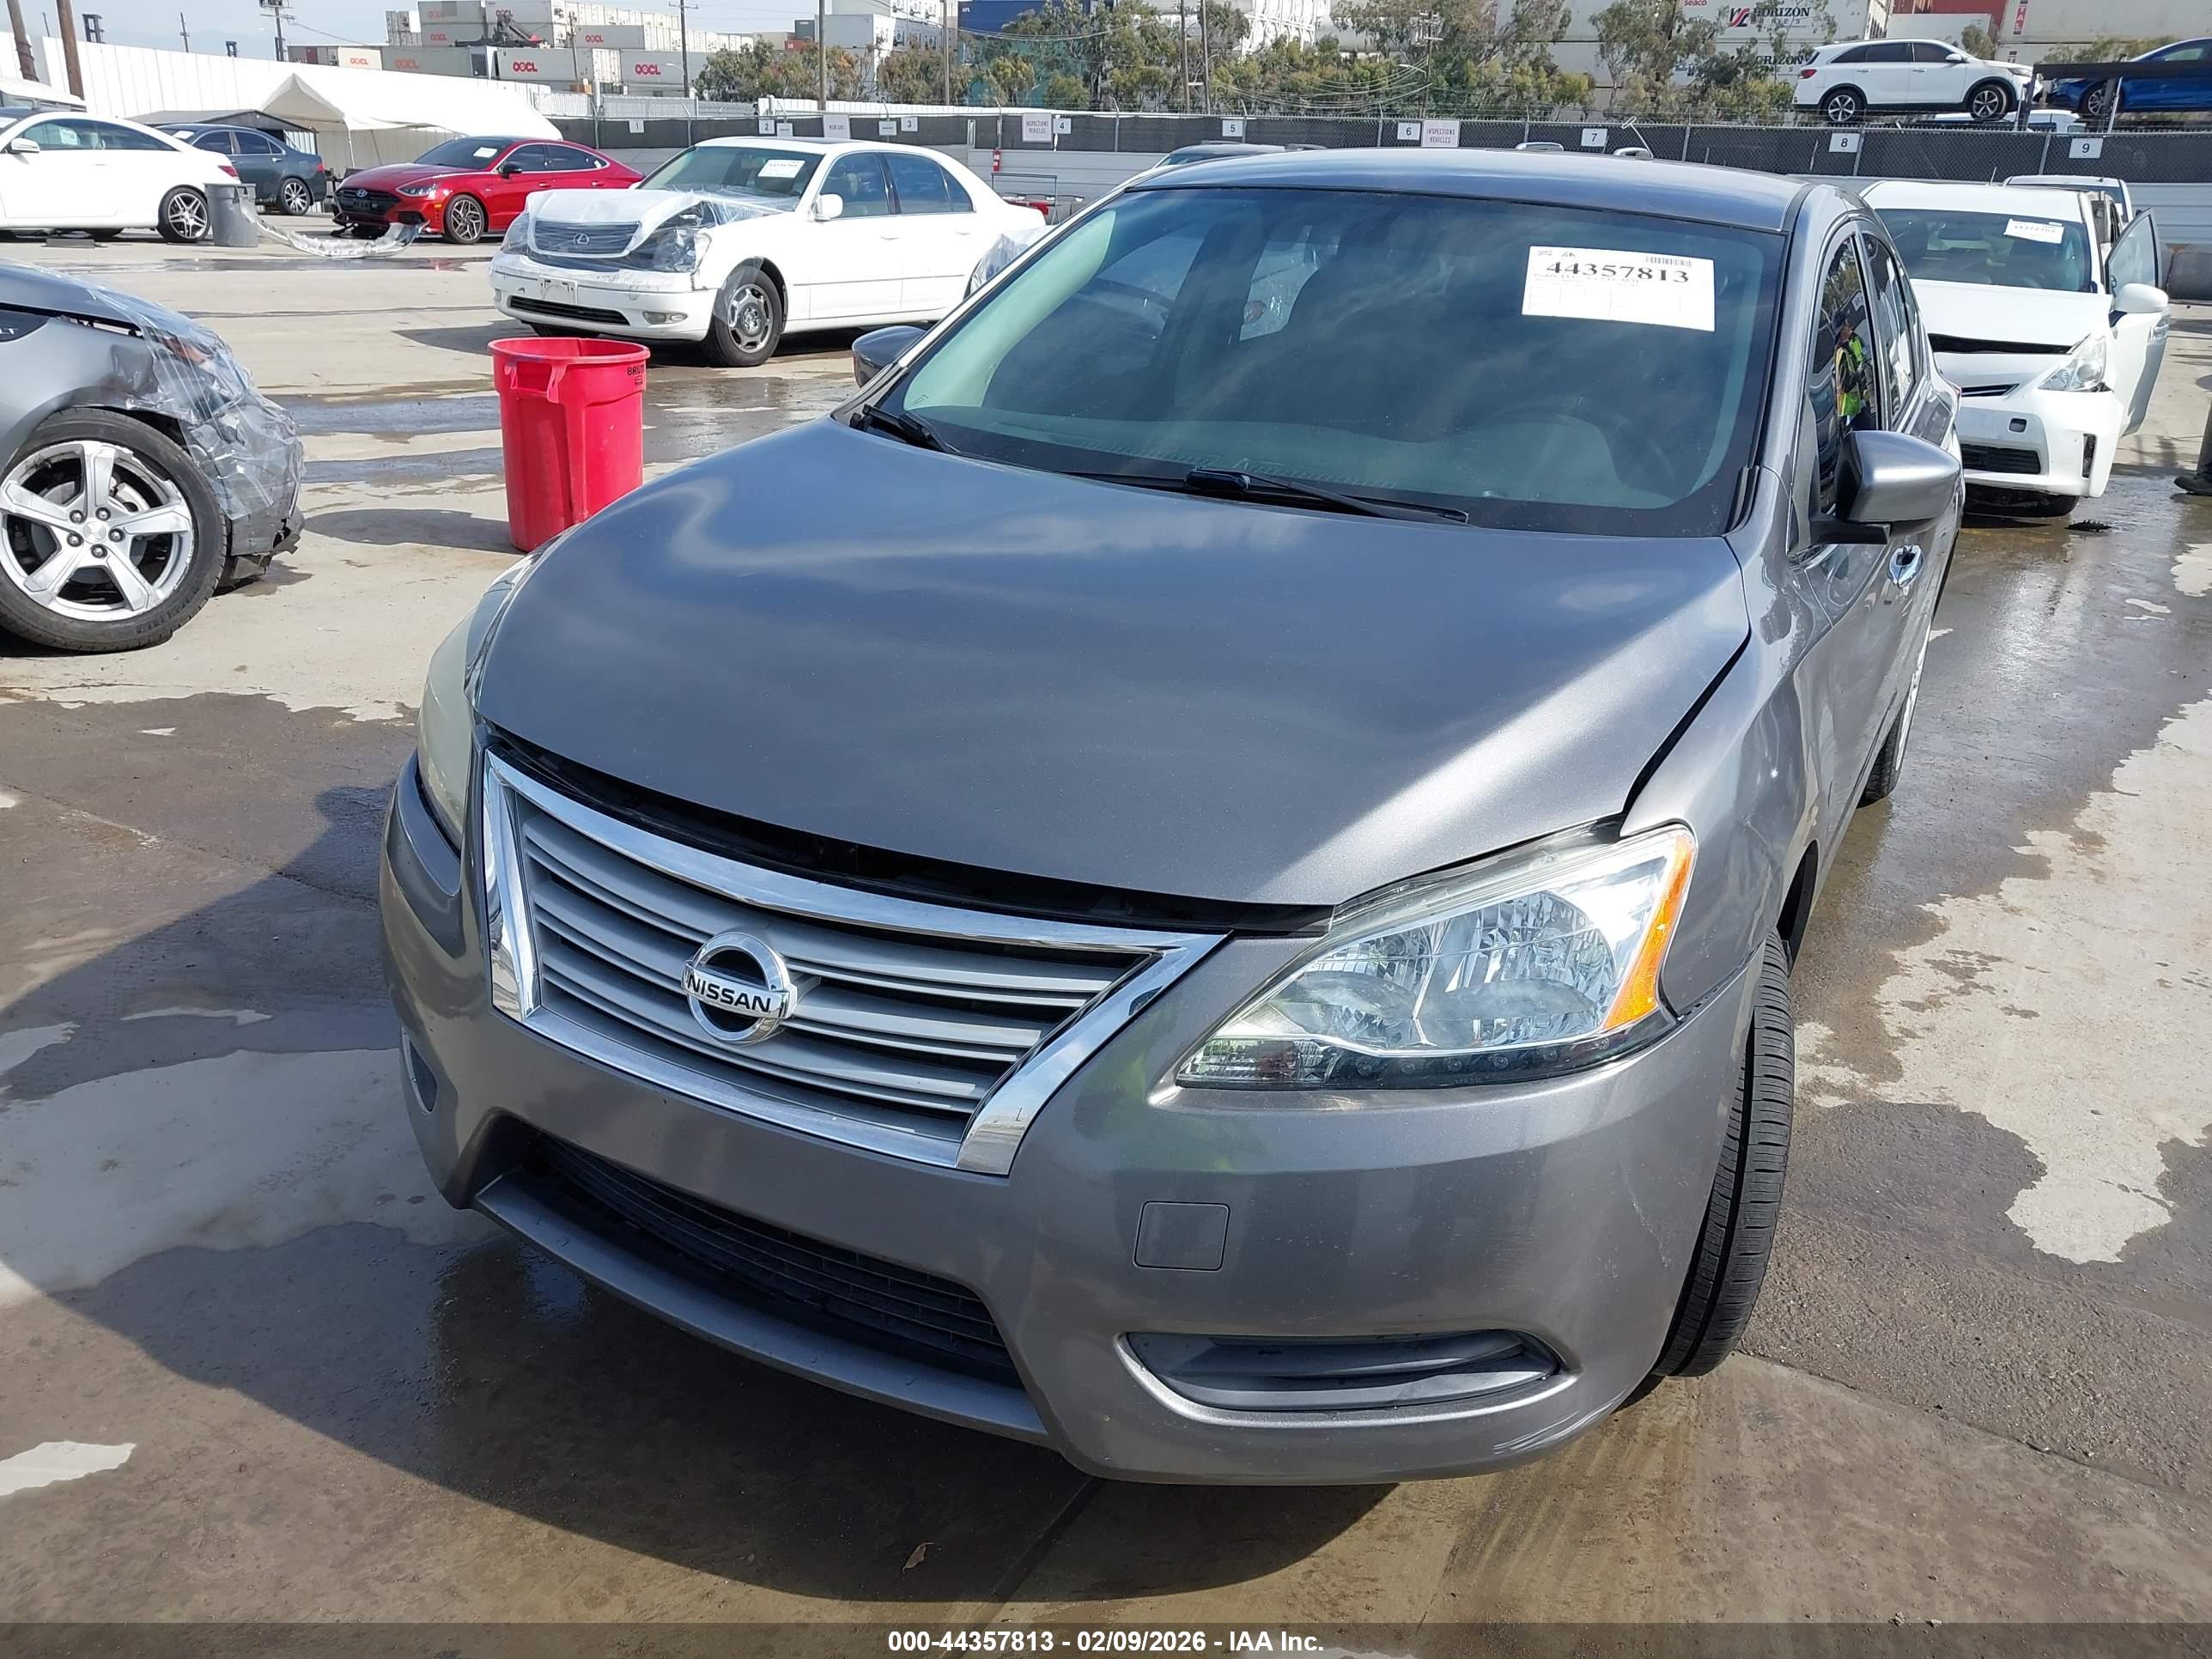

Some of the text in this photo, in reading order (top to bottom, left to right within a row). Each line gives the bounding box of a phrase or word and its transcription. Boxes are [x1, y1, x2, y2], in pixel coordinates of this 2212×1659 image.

[586, 34, 604, 43] OOCL
[513, 62, 538, 72] OOCL
[635, 64, 660, 76] OOCL
[1230, 124, 1236, 133] 5
[1406, 127, 1413, 136] 6
[1591, 132, 1598, 142] 7
[1840, 137, 1848, 147] 8
[2081, 143, 2090, 154] 9
[1546, 261, 1689, 283] 44357813
[687, 973, 771, 1014] NISSAN
